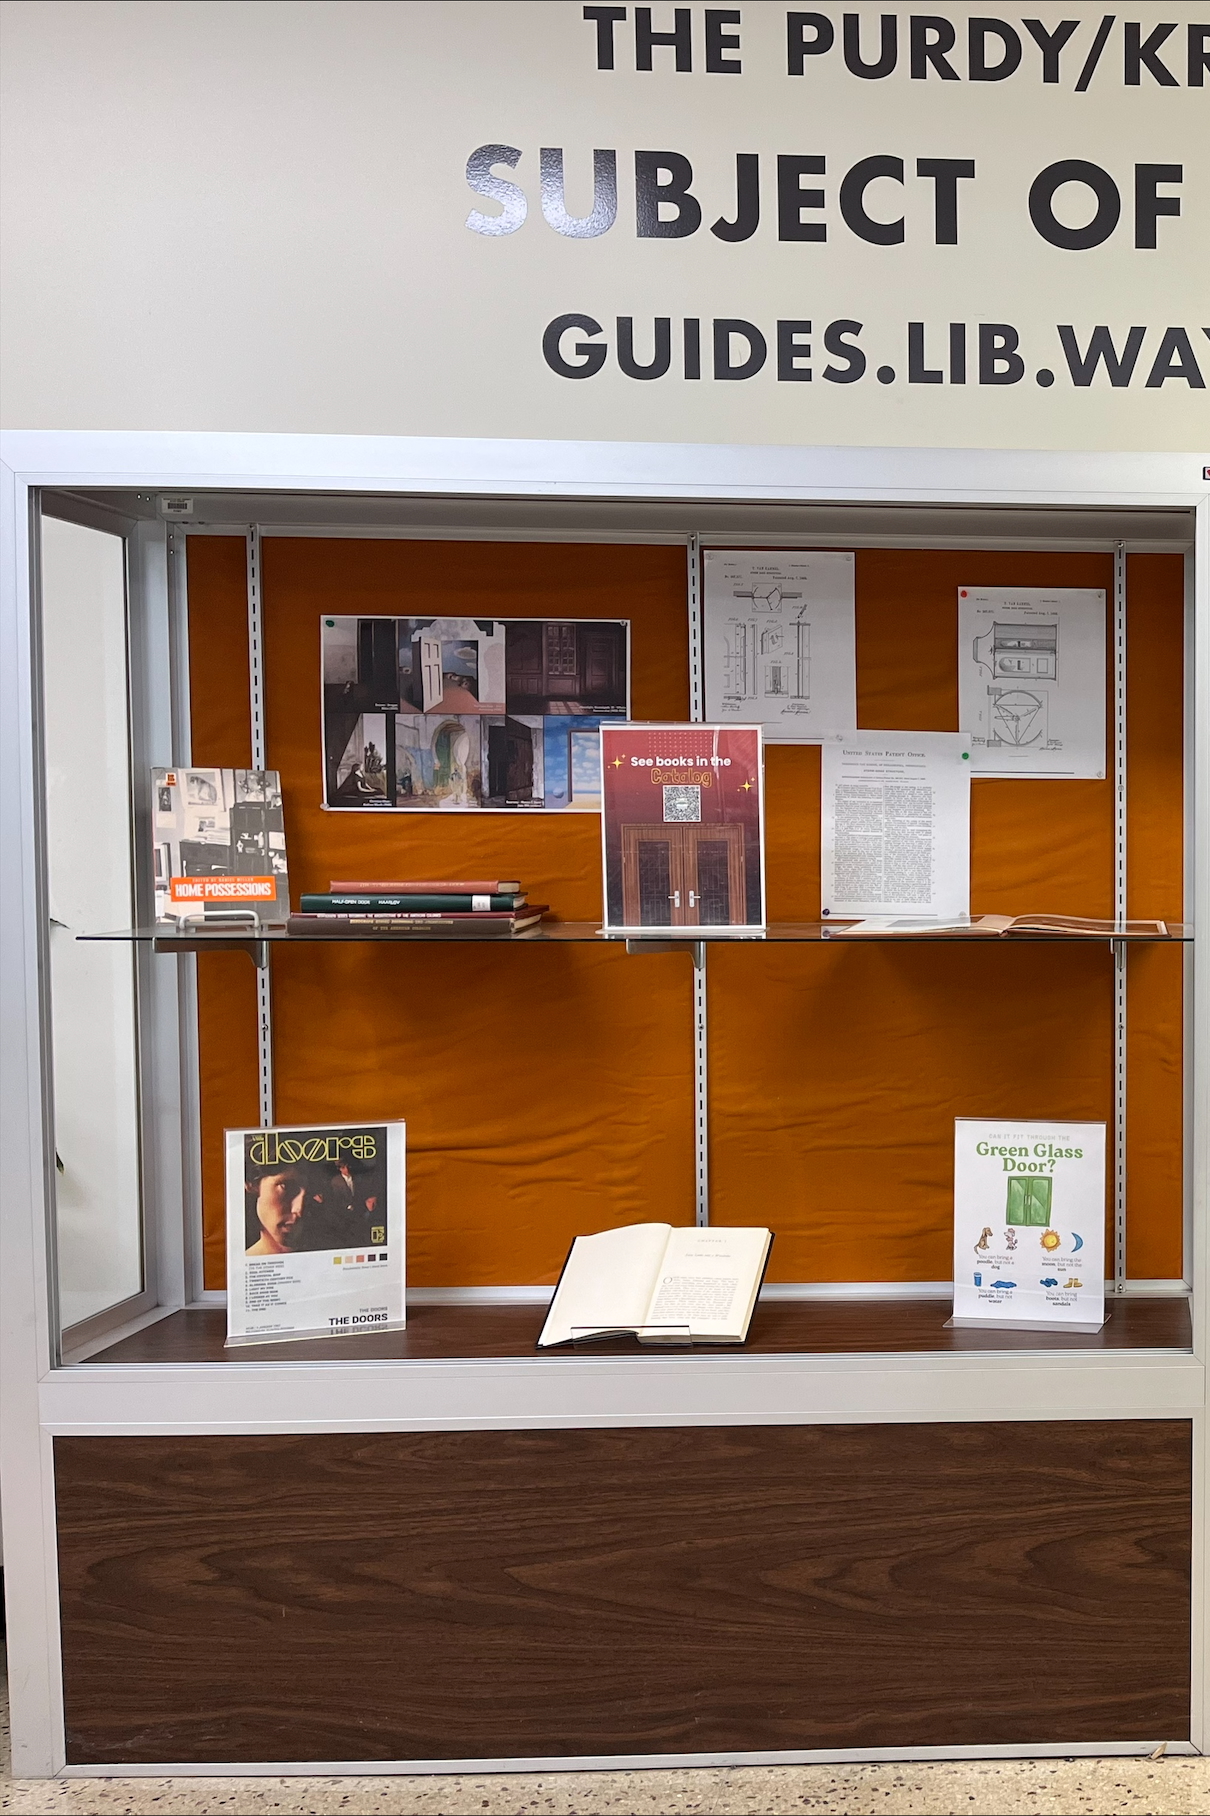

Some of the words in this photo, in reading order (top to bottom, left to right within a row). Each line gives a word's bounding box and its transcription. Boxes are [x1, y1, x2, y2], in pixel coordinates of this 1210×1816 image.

[583, 5, 742, 74] THE
[464, 143, 976, 245] SUBJECT
[1028, 158, 1183, 250] OF
[630, 757, 653, 767] See
[656, 756, 694, 767] books
[696, 756, 707, 766] in
[710, 756, 731, 767] the
[651, 768, 712, 788] Catalog
[175, 884, 203, 897] HOME
[205, 883, 271, 896] POSSESSIONS
[976, 1142, 1029, 1157] Green
[1034, 1144, 1083, 1158] Glass
[1003, 1158, 1056, 1173] Door?
[329, 1317, 350, 1326] THE
[352, 1313, 388, 1324] DOORS
